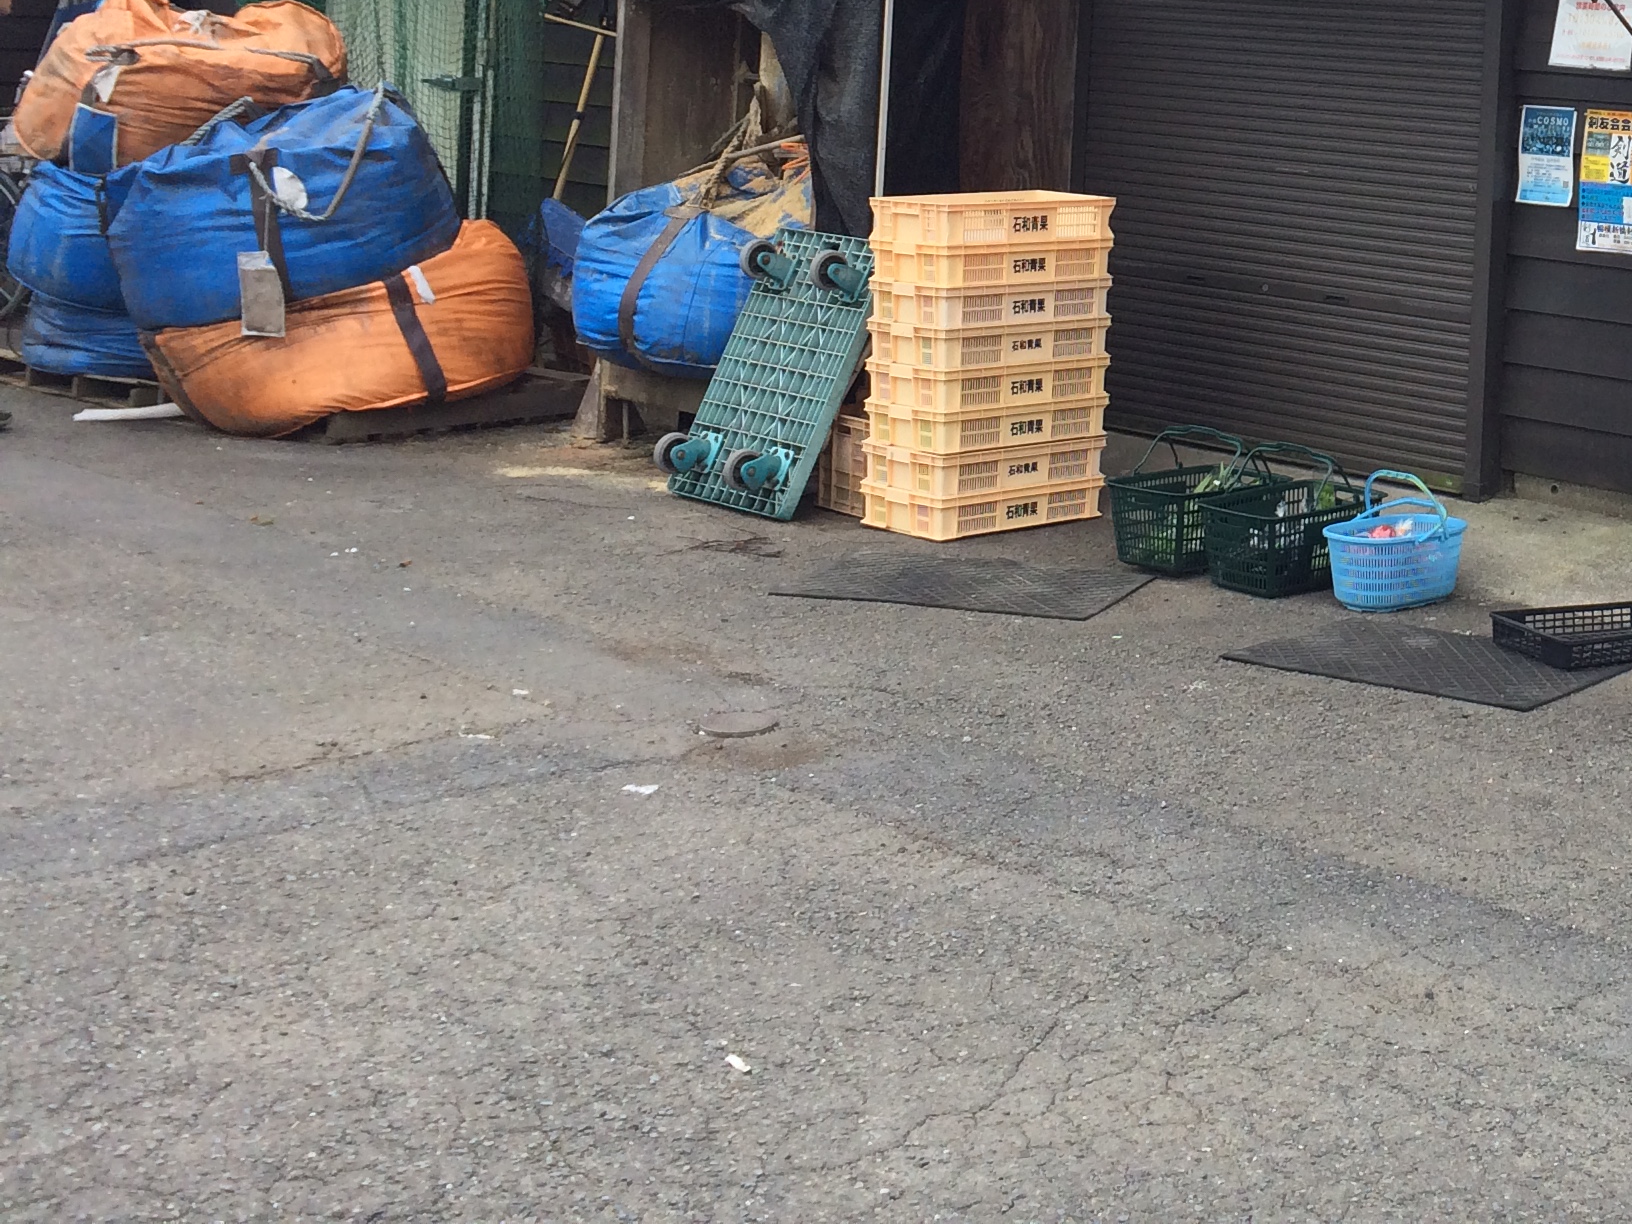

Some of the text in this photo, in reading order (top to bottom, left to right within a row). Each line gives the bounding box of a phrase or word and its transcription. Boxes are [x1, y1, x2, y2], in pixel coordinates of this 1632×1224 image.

[1013, 215, 1048, 233] 石和青果
[1013, 258, 1046, 273] 石和青果
[1012, 298, 1045, 314] 石和青果
[1012, 338, 1042, 351] 石和青果
[1011, 378, 1043, 395] 石和青果
[1011, 419, 1043, 436] 石和青果
[1008, 462, 1038, 476] 石和青果
[1006, 502, 1038, 519] 石和青果
